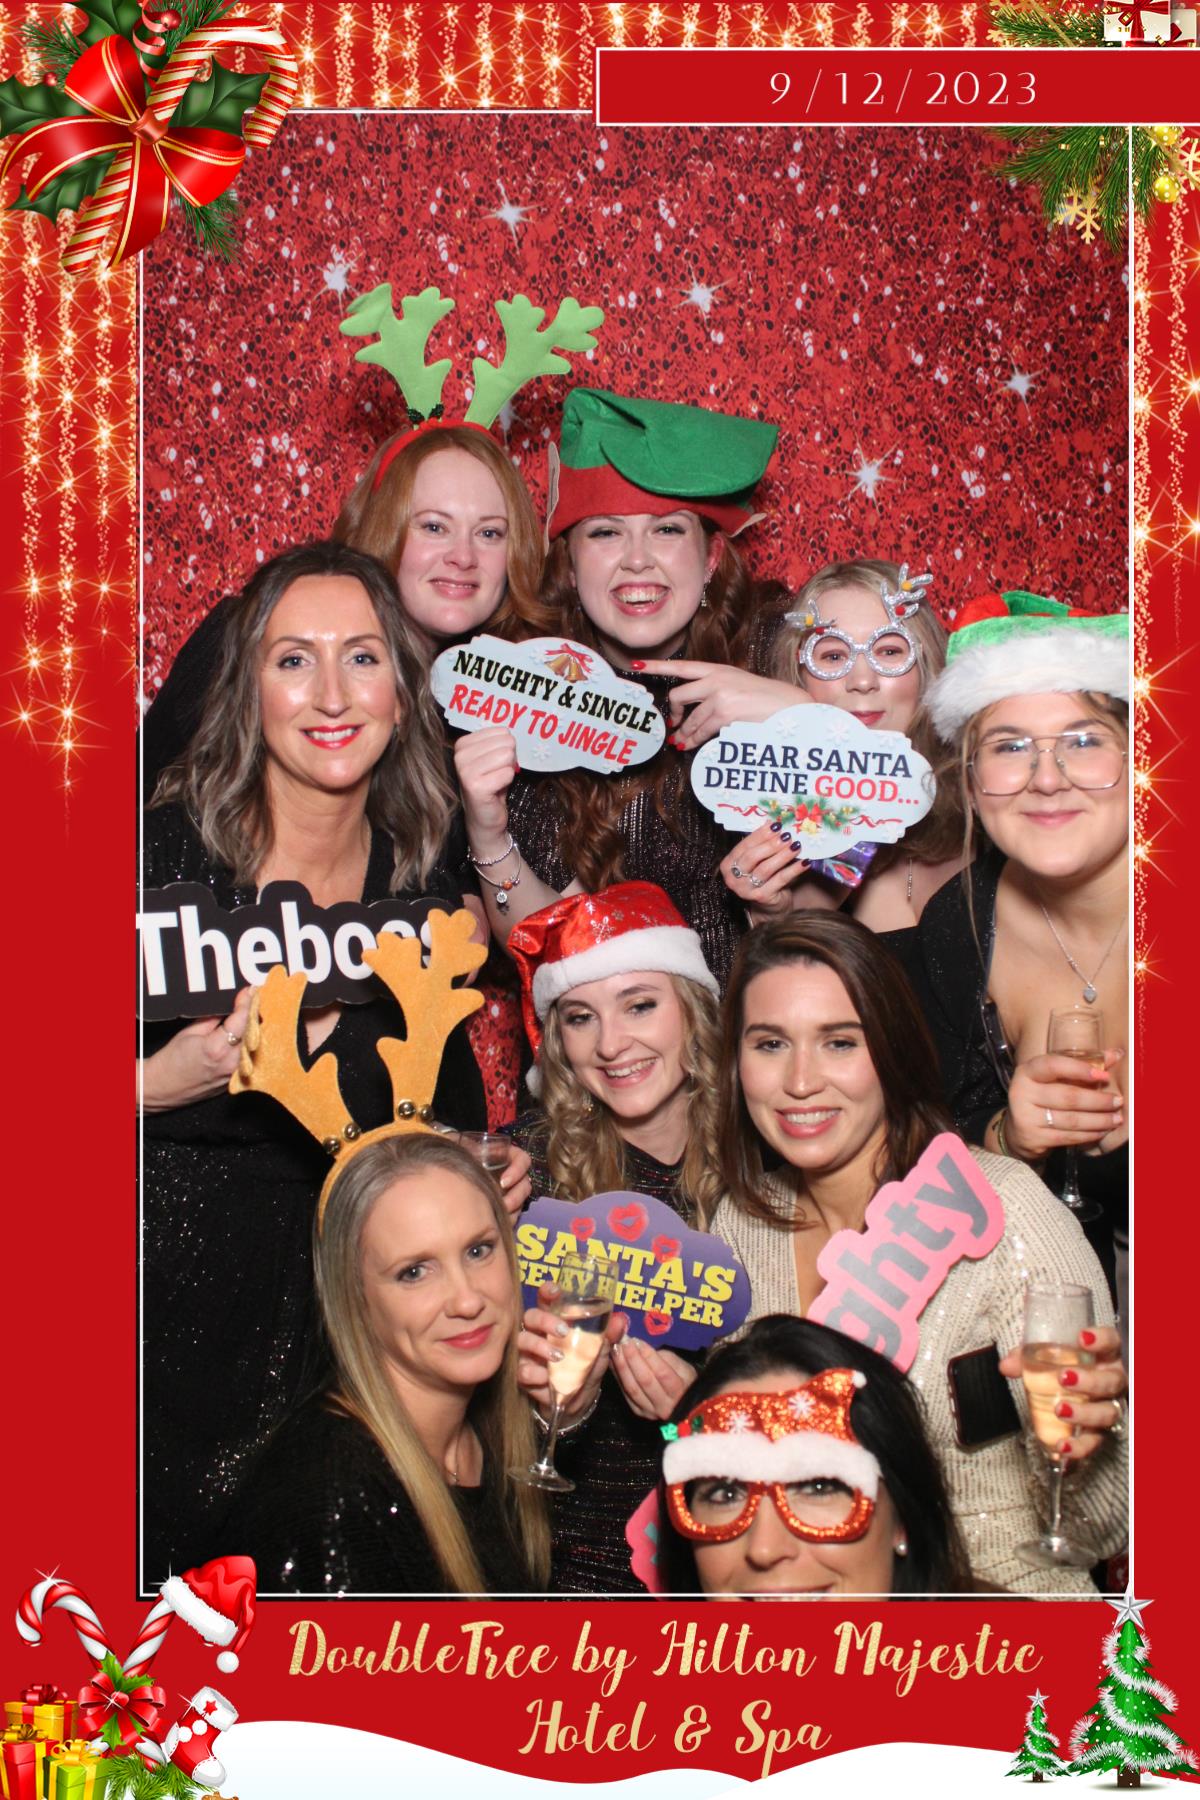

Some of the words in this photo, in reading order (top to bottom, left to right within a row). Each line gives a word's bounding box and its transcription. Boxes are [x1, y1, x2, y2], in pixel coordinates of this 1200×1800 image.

[449, 684, 528, 729] READY
[527, 709, 559, 740] TO
[558, 720, 638, 765] JINGLE
[452, 650, 559, 702] NAUGHTY
[558, 685, 577, 709] &
[577, 690, 658, 734] SINGLE
[703, 766, 809, 796] DEFINE
[814, 775, 920, 805] GOOD...
[717, 741, 800, 770] DEAR
[806, 747, 913, 778] SANTA
[136, 901, 432, 997] Thebo
[515, 1224, 737, 1303] SANTA'S
